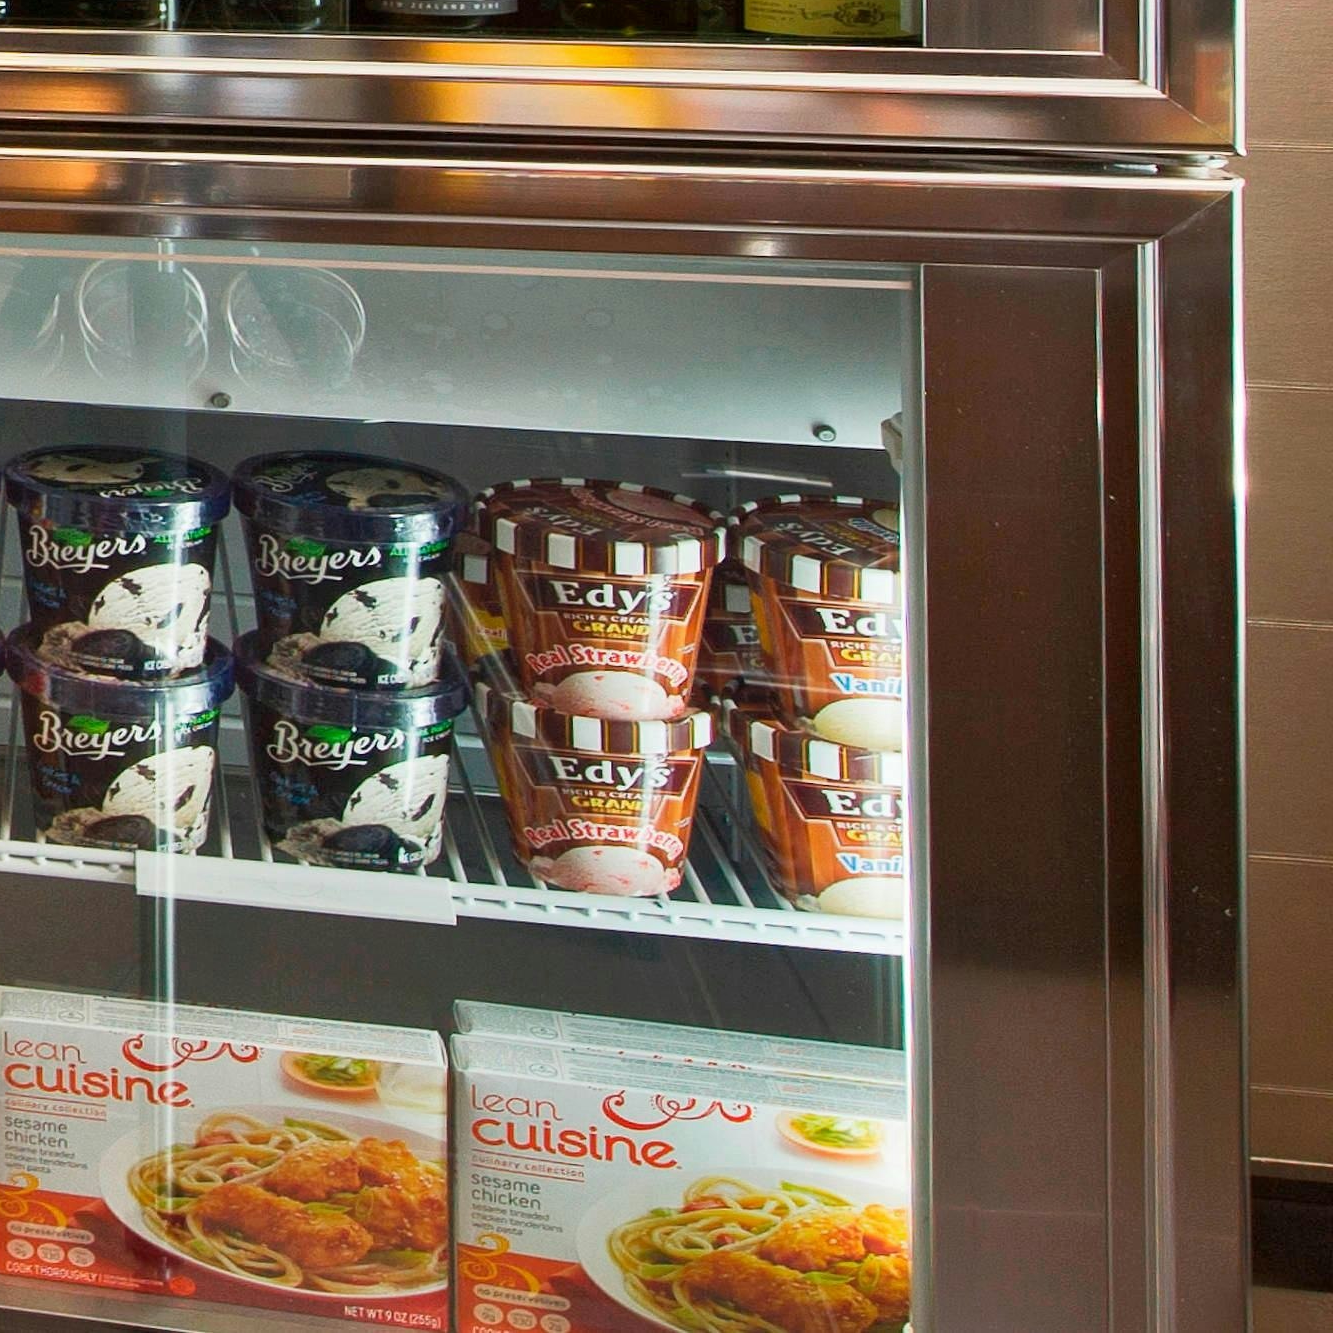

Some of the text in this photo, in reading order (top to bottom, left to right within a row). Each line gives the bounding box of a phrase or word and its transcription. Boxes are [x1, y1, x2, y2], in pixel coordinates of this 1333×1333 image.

[25, 524, 147, 574] Breyers
[255, 533, 382, 585] Breyers
[548, 579, 674, 615] Edy's
[526, 644, 690, 687] Real Strawberry
[33, 710, 162, 761] Breyers
[266, 719, 406, 771] Breyers
[547, 754, 673, 788] Edy's
[526, 818, 684, 862] Real Strawberry
[2, 1030, 88, 1065] lean
[2, 1062, 193, 1108] cuisine
[470, 1083, 563, 1122] lean
[4, 1116, 69, 1135] sesame
[4, 1129, 69, 1149] chicken
[470, 1117, 678, 1170] cuisine
[471, 1172, 542, 1195] sesame
[471, 1188, 542, 1211] chicken
[344, 1304, 365, 1319] NET
[366, 1307, 384, 1322] WT
